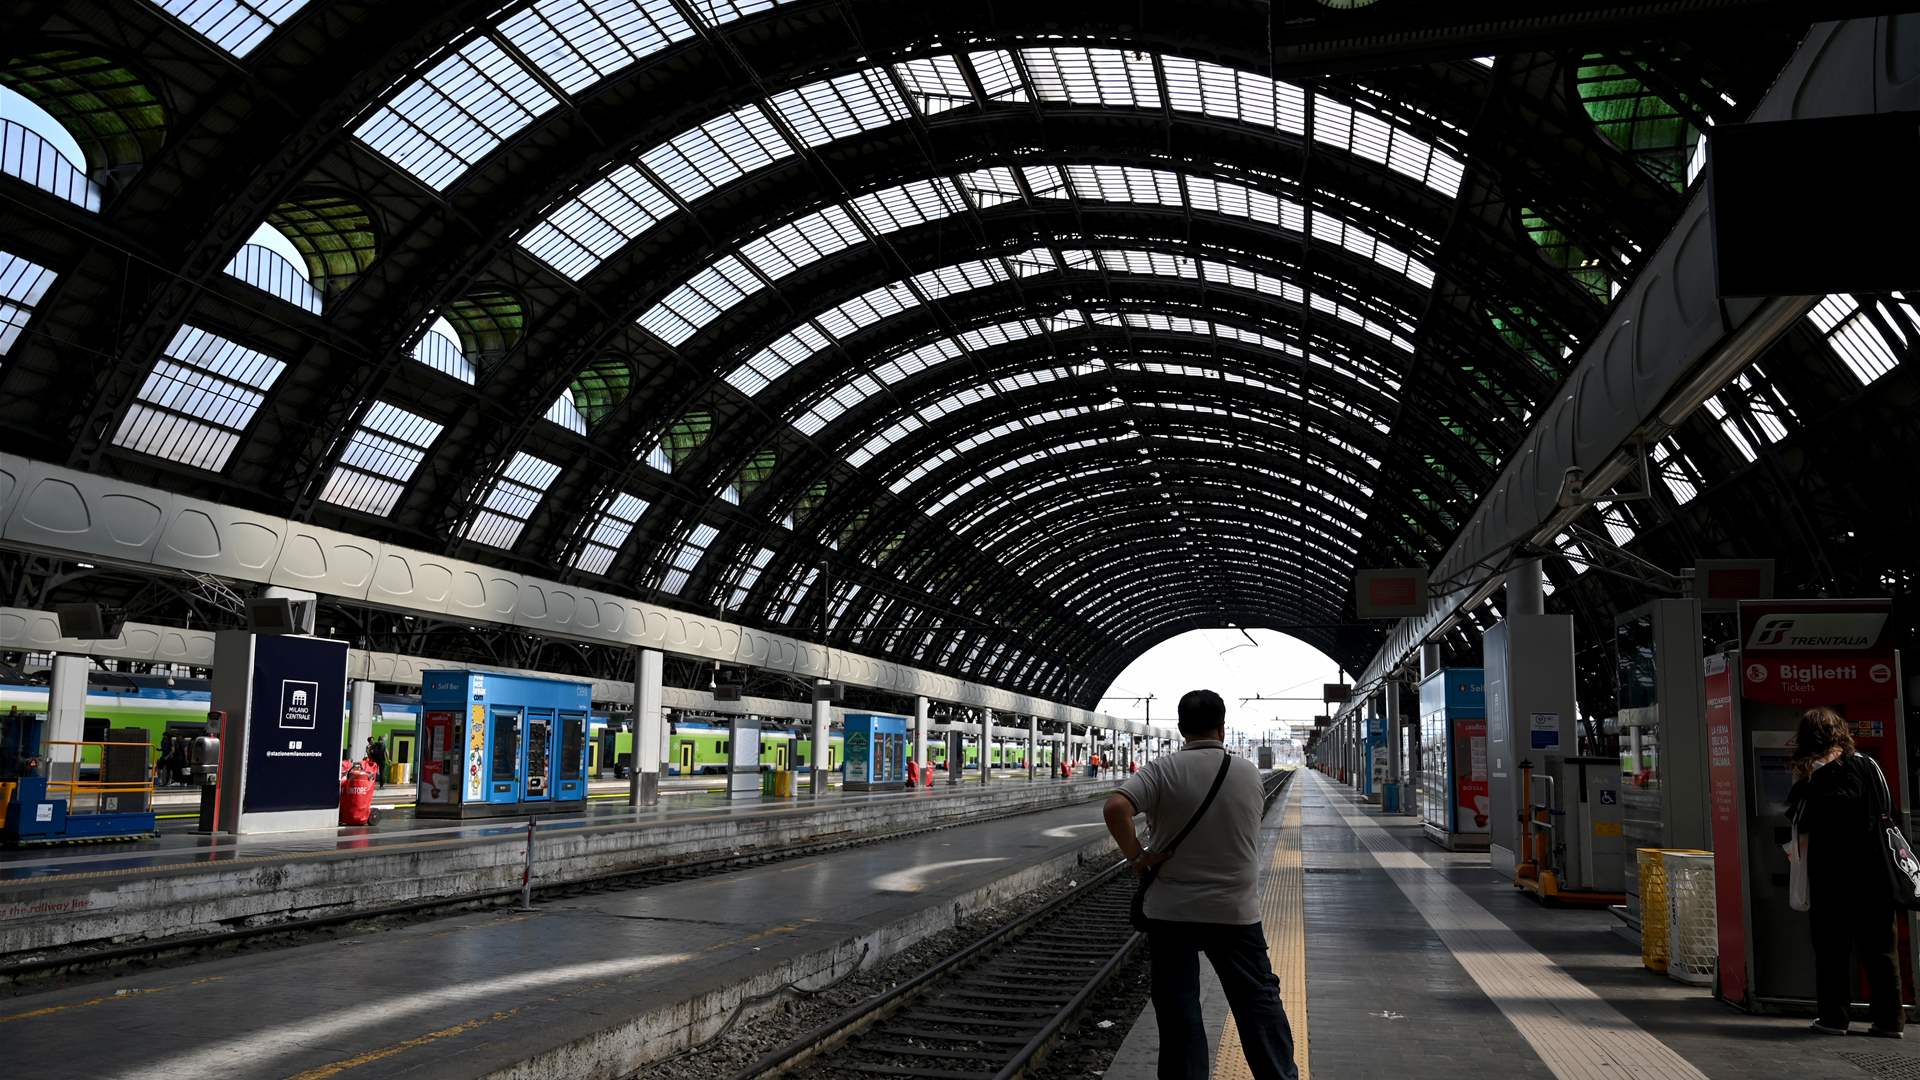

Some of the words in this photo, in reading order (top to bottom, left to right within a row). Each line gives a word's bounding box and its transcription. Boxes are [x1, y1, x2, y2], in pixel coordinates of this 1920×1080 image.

[1791, 636, 1869, 646] TRENITALIA
[1779, 663, 1857, 683] Biglietti
[1782, 682, 1816, 693] Tickets
[288, 706, 309, 714] MILANO
[285, 713, 311, 721] CENTRALE
[30, 901, 70, 914] railway
